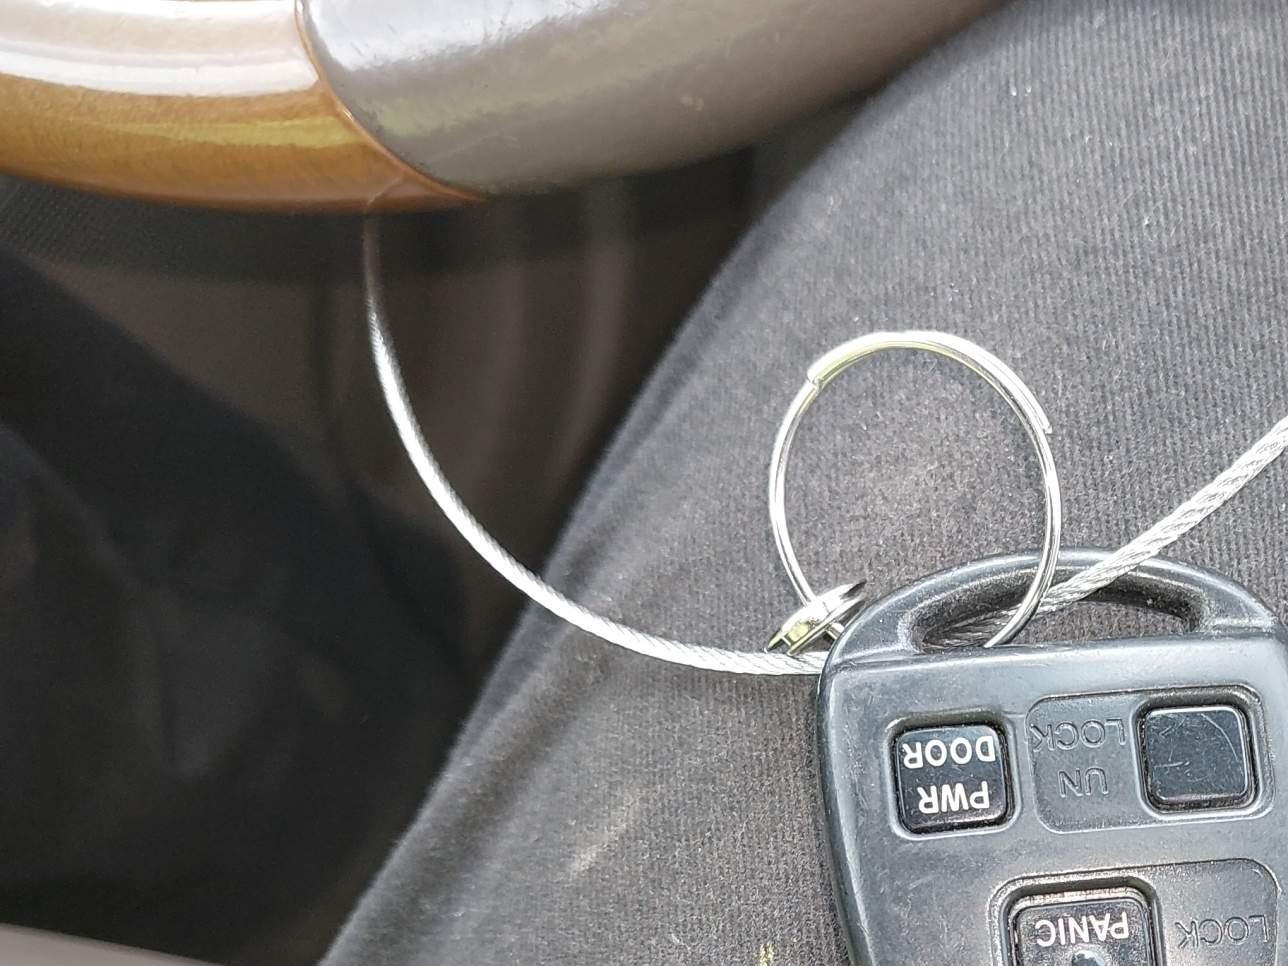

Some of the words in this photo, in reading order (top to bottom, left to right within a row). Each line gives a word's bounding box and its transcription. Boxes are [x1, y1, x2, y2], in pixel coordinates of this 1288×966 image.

[1030, 718, 1127, 752] LOCK
[903, 736, 996, 769] DOOR
[917, 781, 990, 814] PWR
[1058, 767, 1109, 798] UN
[1035, 911, 1129, 947] PANIC
[1174, 914, 1269, 949] LOCK
